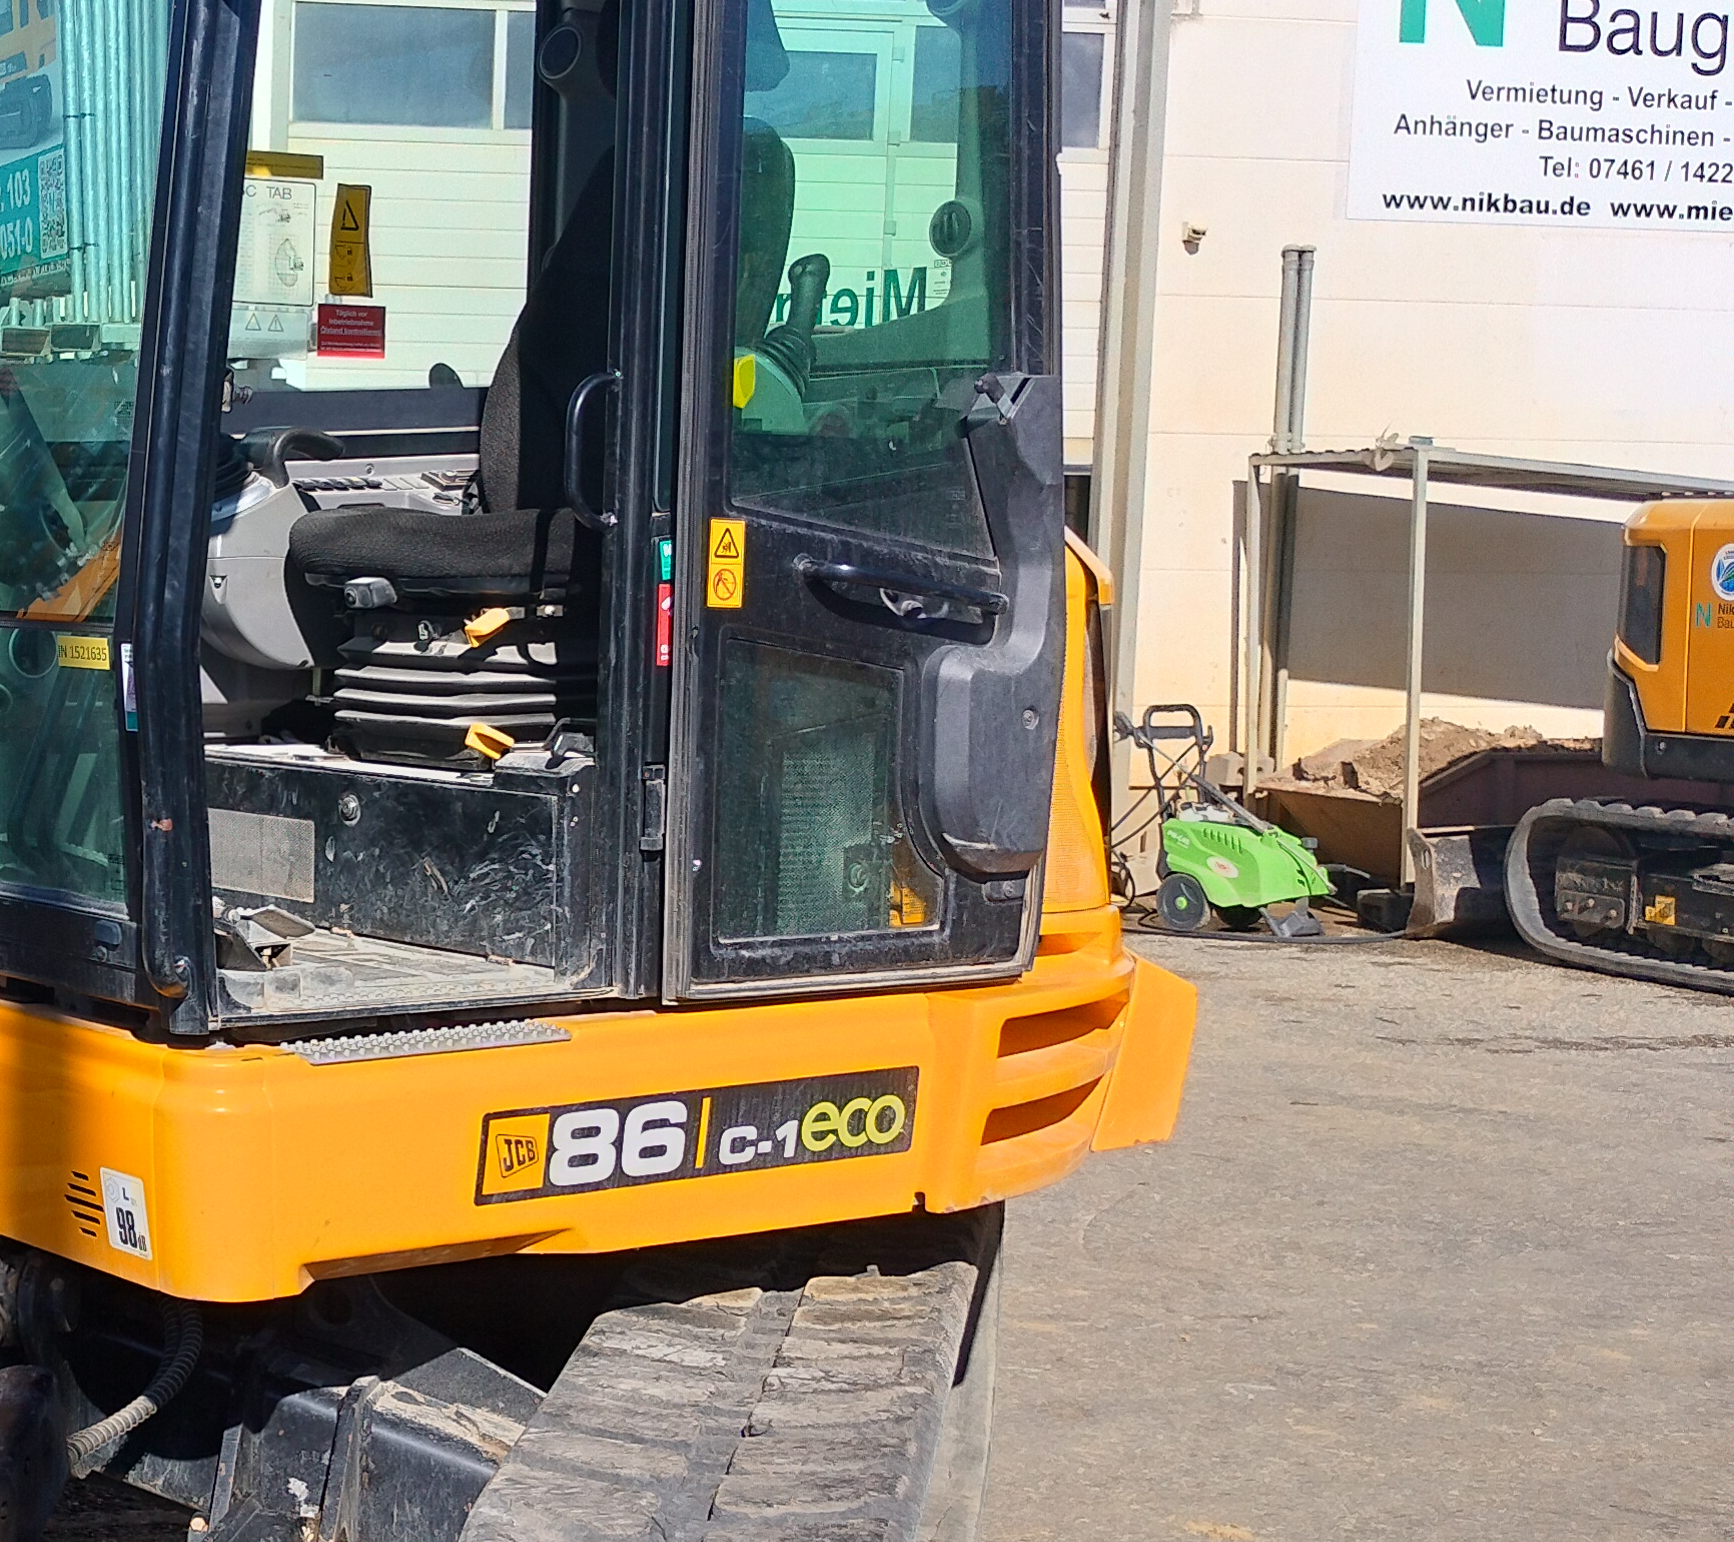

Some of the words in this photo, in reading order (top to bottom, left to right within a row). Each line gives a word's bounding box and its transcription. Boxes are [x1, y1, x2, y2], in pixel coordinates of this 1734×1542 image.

[1466, 79, 1604, 112] Vermietung
[1627, 86, 1719, 110] Verkauf
[1393, 113, 1515, 144] Anhänger
[1537, 119, 1715, 147] Baumaschinen
[1539, 155, 1580, 178] Tel:
[1589, 157, 1656, 181] 07461
[1680, 161, 1734, 184] 1422
[6, 167, 31, 209] 103
[1382, 191, 1591, 217] www.nikbau.de
[1695, 602, 1712, 627] N
[69, 645, 107, 661] 1521635
[500, 1136, 536, 1177] JCB
[548, 1100, 688, 1187] 86
[116, 1206, 137, 1248] 98
